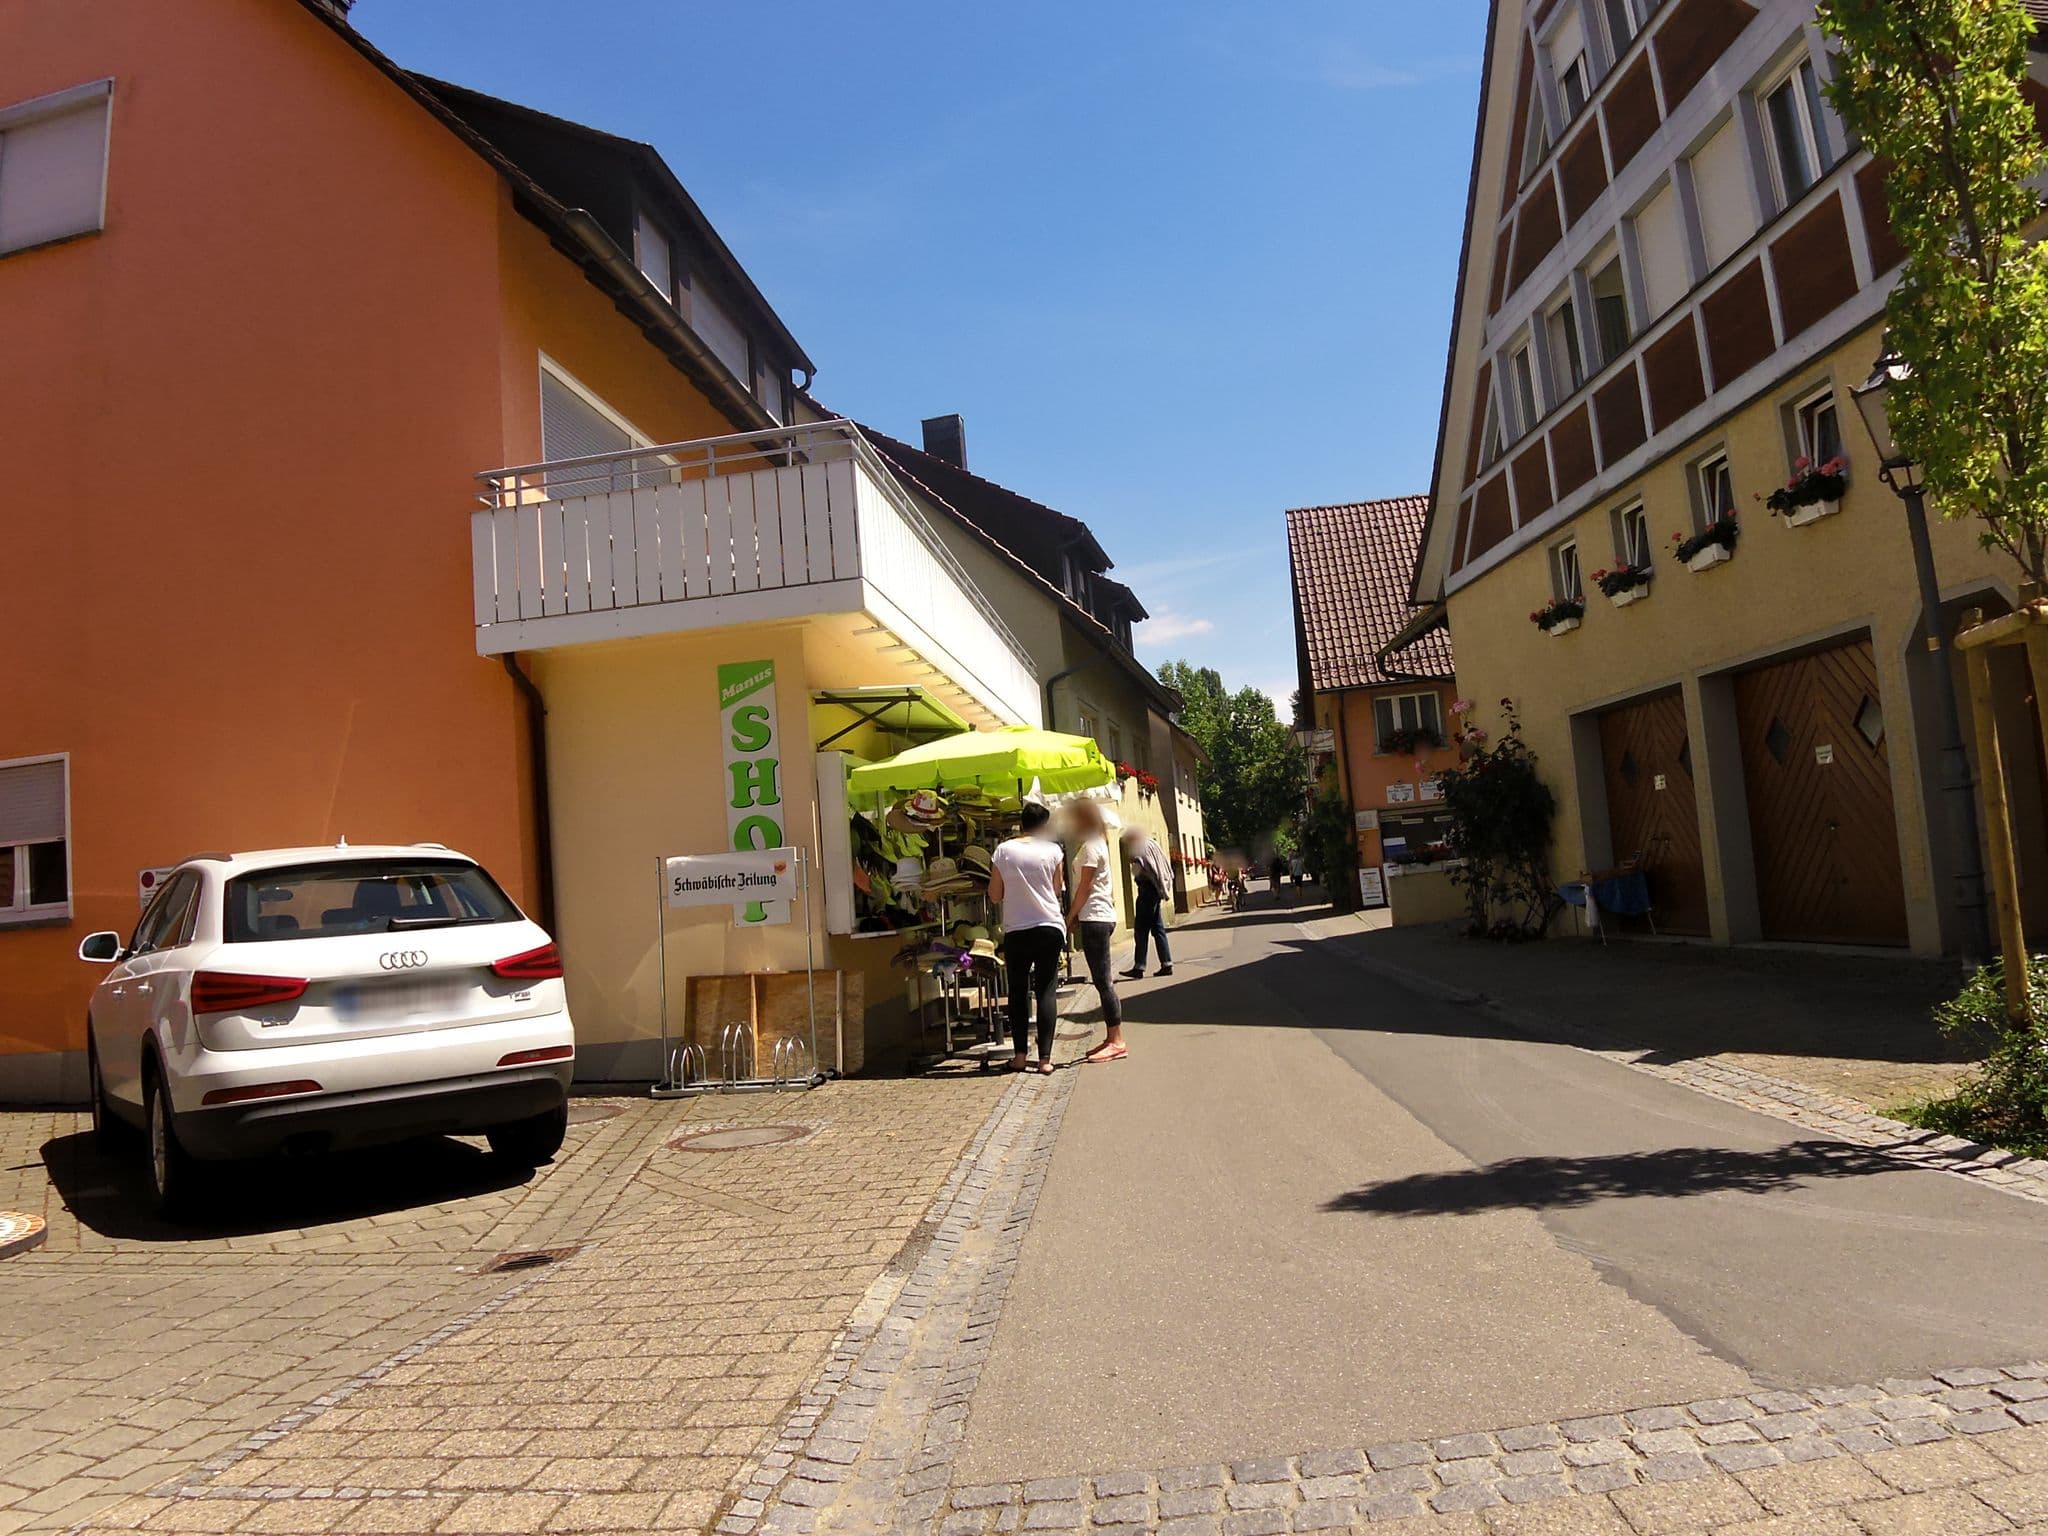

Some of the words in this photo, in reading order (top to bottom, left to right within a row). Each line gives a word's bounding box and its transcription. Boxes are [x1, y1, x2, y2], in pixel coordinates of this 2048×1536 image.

[721, 666, 773, 702] Manus
[673, 874, 737, 896] Schwäbische
[737, 872, 778, 891] Zeitung
